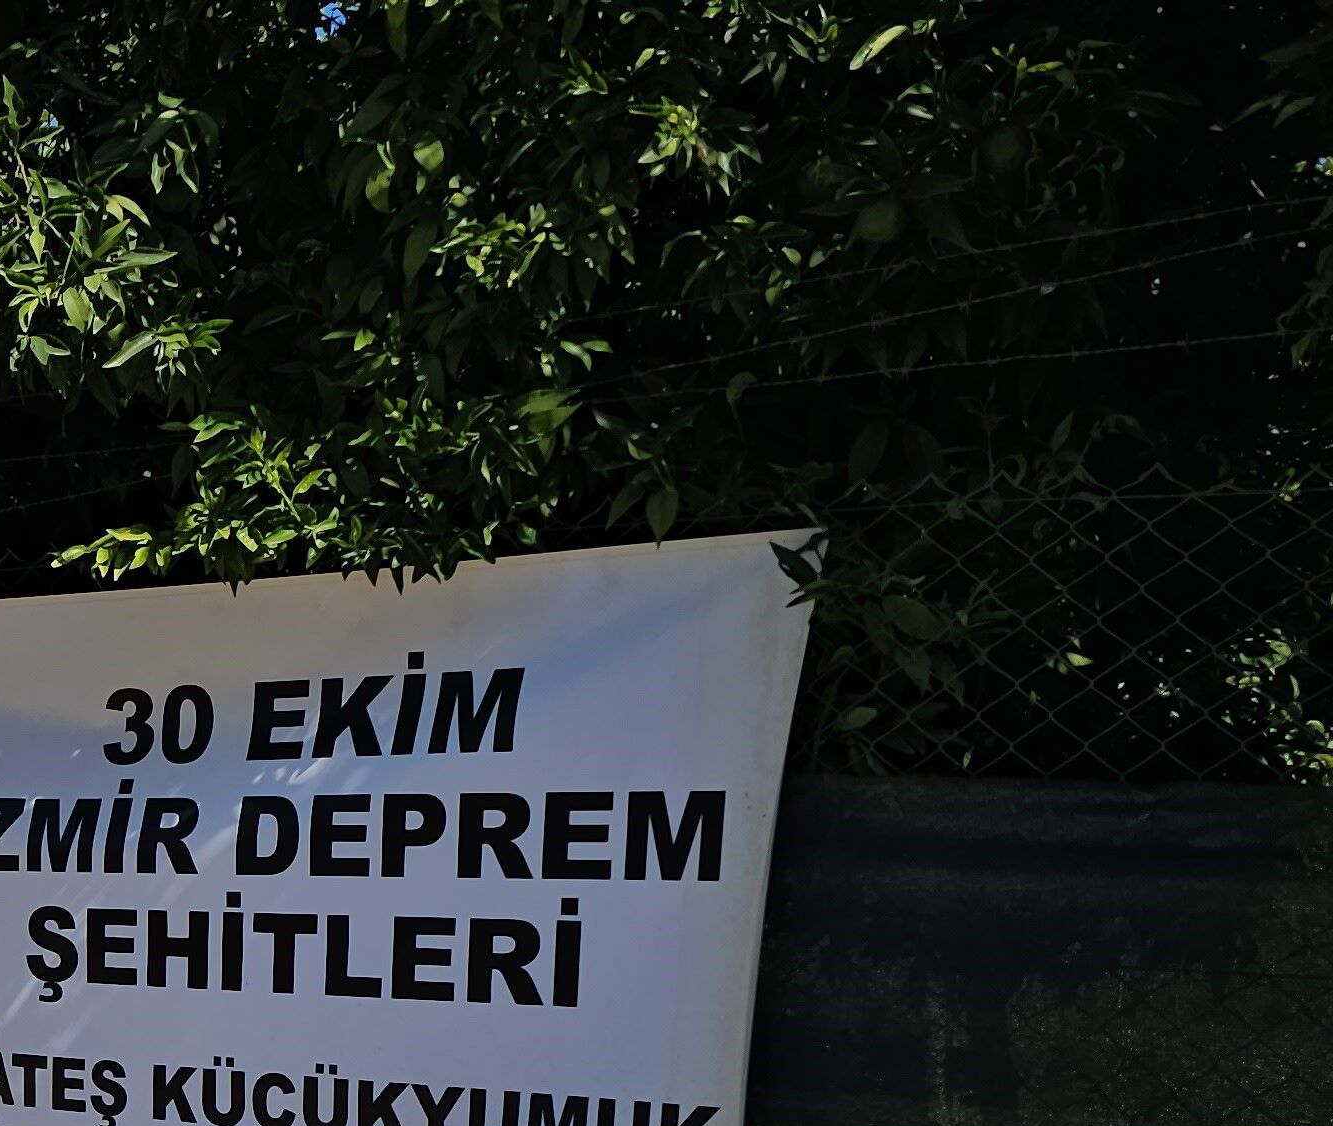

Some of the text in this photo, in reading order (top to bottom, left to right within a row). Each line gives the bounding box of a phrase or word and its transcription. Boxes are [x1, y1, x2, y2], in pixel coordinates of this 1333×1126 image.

[103, 650, 526, 766] 30 EKİM
[235, 791, 727, 882] DEPREM
[25, 891, 582, 1008] ŞEHİTLERİ
